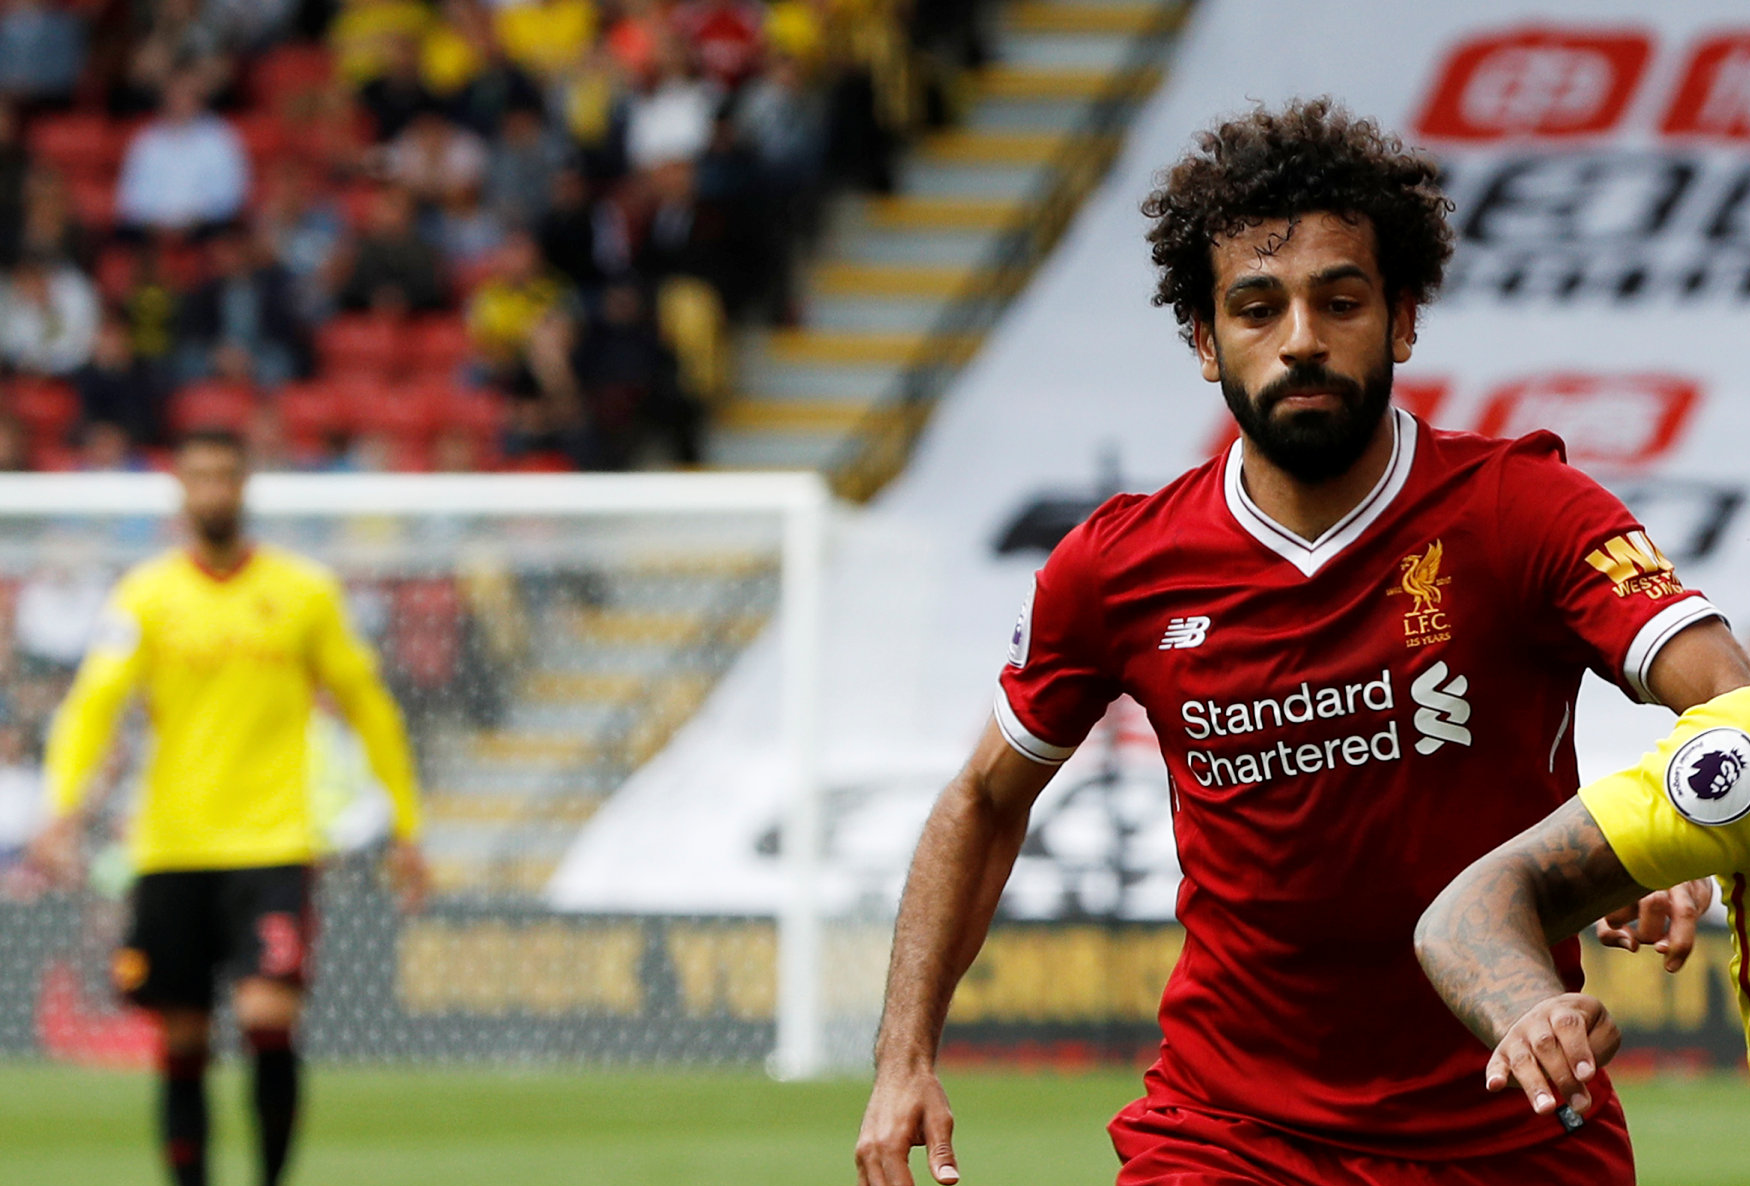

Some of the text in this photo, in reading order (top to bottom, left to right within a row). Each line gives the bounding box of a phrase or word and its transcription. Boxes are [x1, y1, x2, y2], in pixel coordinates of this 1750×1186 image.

[1420, 632, 1452, 645] YEARS
[1181, 669, 1395, 740] Standard
[1187, 720, 1401, 787] Chartered
